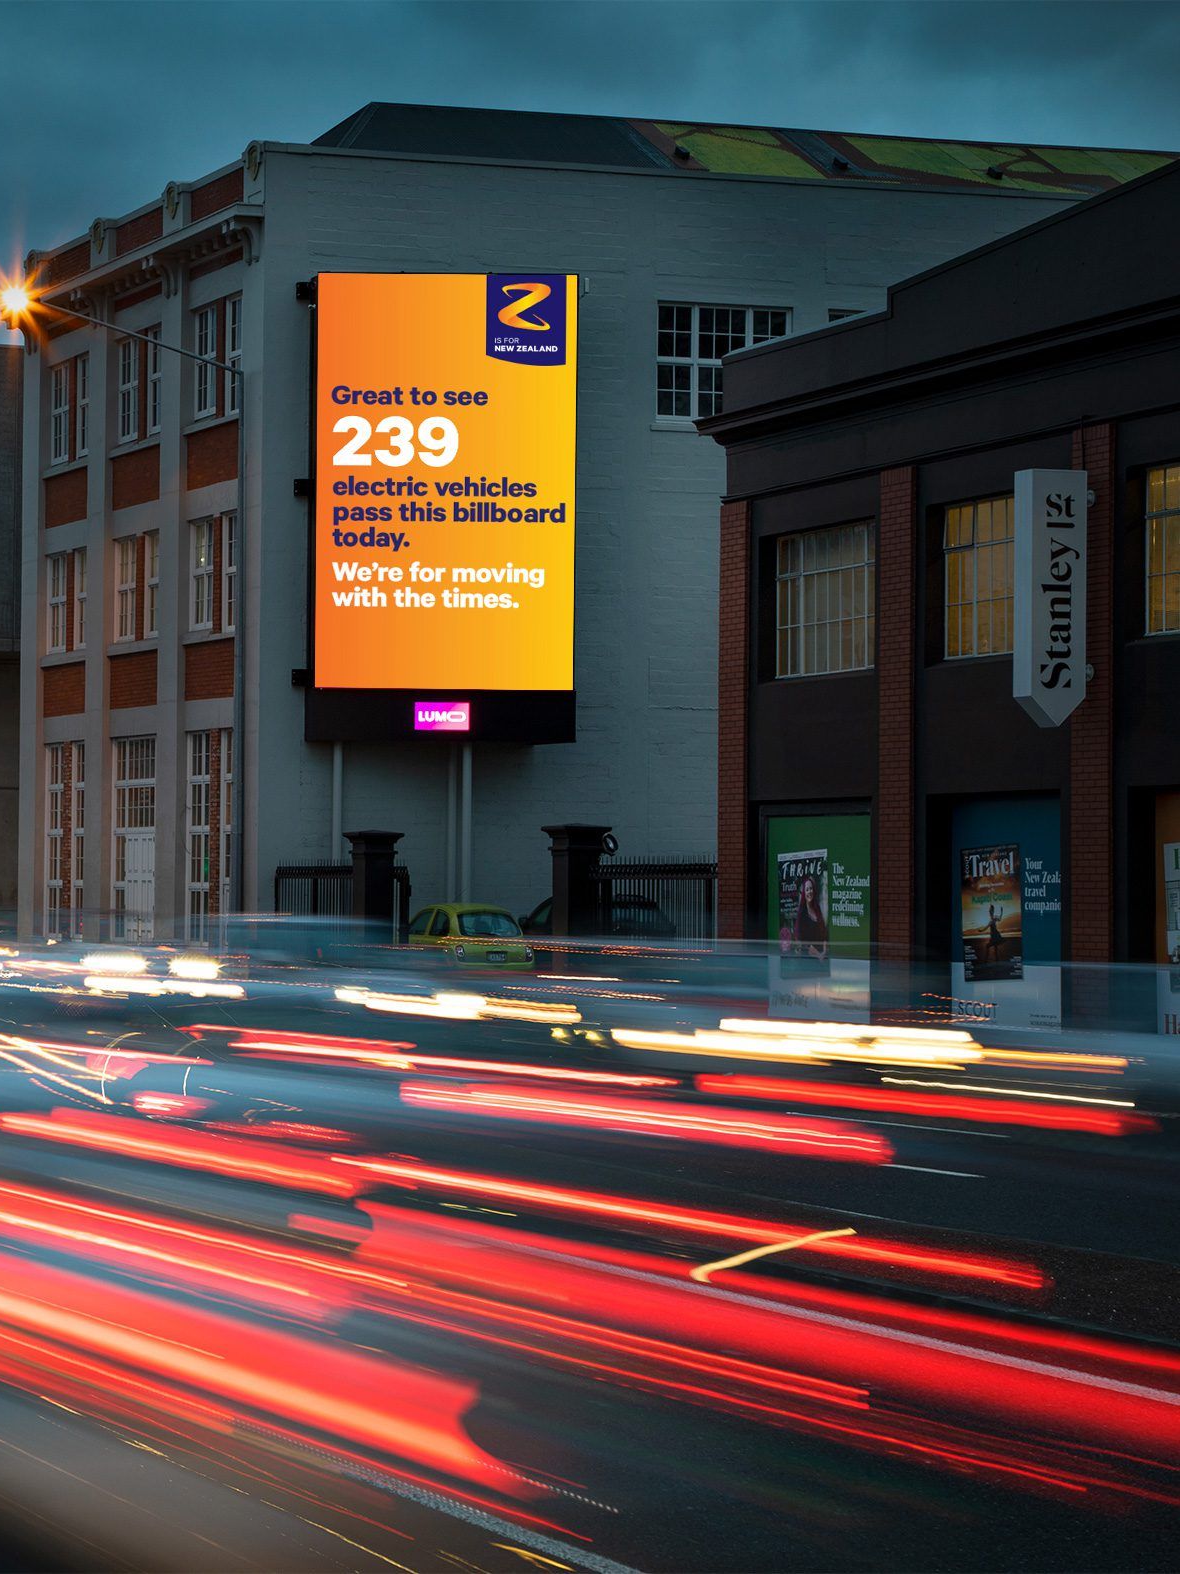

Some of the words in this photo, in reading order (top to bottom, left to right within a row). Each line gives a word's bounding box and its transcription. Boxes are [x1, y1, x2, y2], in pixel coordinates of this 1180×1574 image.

[516, 345, 558, 353] ZEALAND
[331, 385, 403, 406] Great
[410, 387, 438, 405] to
[444, 390, 489, 406] see
[332, 415, 459, 468] 239
[332, 475, 428, 497] electric
[435, 476, 538, 498] vehicles
[332, 505, 392, 527] pass
[399, 501, 447, 523] this
[453, 502, 566, 523] billboard
[1047, 493, 1076, 518] St
[331, 527, 410, 552] today.
[409, 562, 447, 584] for
[452, 563, 545, 588] moving
[331, 586, 387, 608] with
[393, 587, 436, 608] the
[442, 588, 520, 609] times.
[1040, 538, 1080, 689] Stanley
[418, 710, 466, 722] LUMO
[831, 862, 845, 875] The
[969, 851, 1015, 878] Travel
[1024, 858, 1044, 870] Your
[832, 875, 845, 887] New
[846, 875, 870, 888] Zealand
[1025, 871, 1041, 883] New
[831, 887, 863, 901] magazine
[1024, 885, 1046, 897] travel
[831, 901, 864, 915] redefining
[831, 915, 861, 927] wellness.
